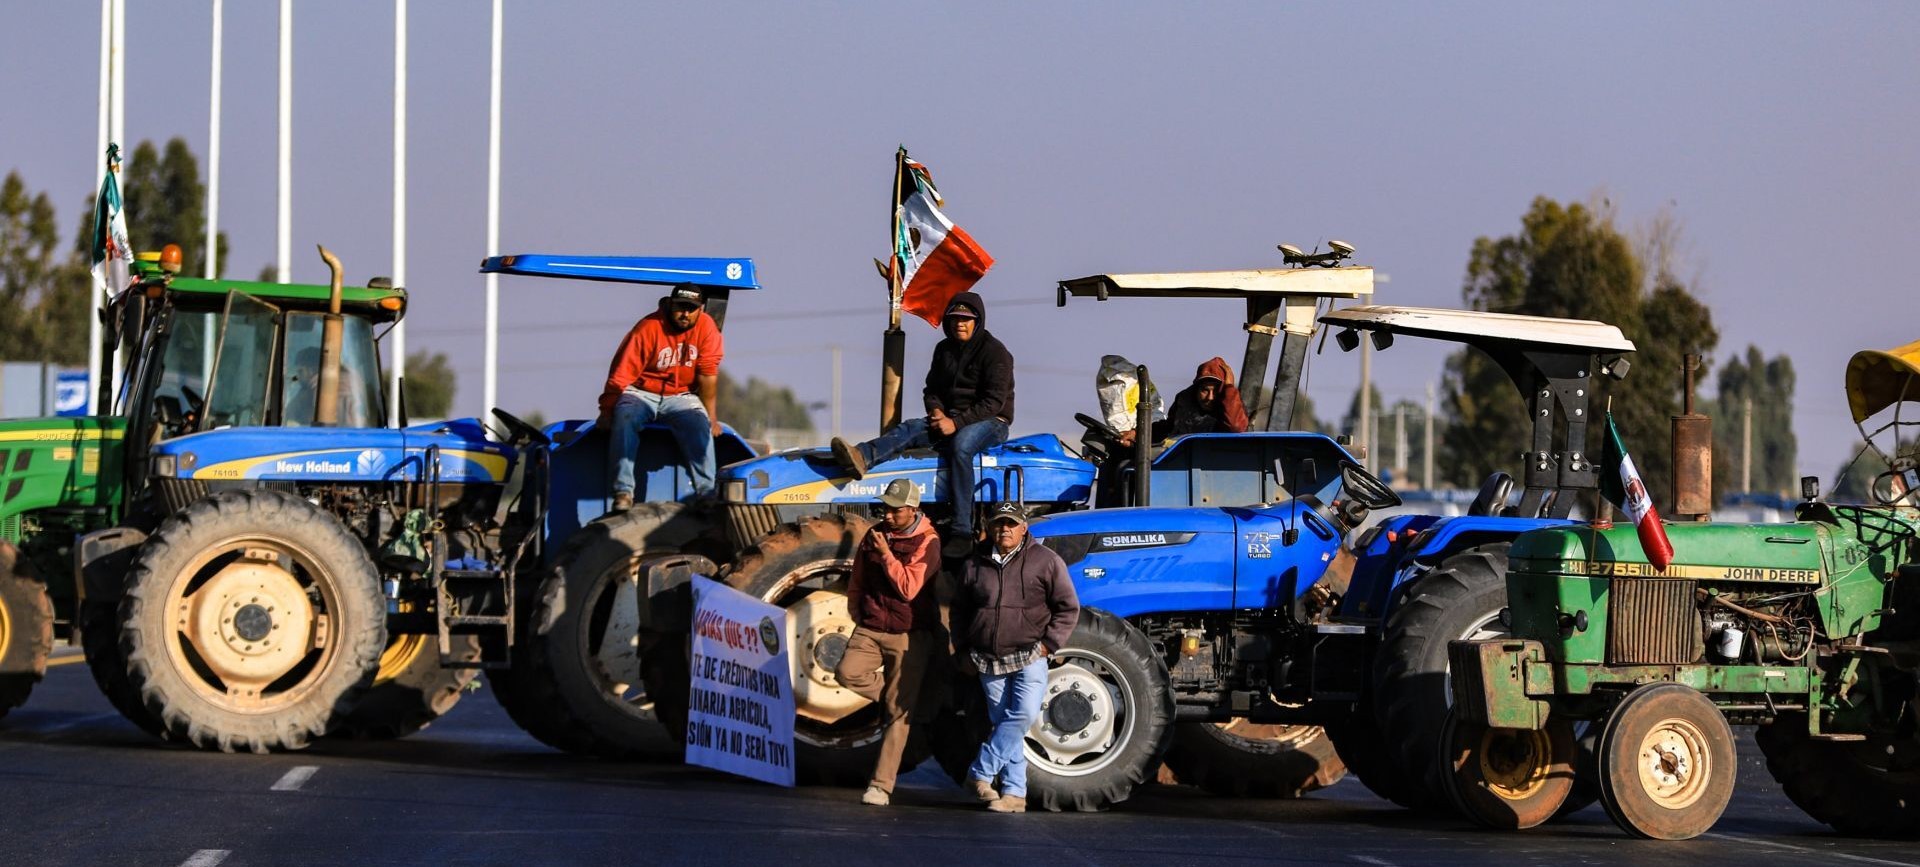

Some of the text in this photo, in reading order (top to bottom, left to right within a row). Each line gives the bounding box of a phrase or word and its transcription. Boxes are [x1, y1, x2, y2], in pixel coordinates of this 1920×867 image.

[213, 469, 239, 477] 7610S
[276, 460, 351, 473] New Holland
[850, 484, 877, 495] New
[784, 493, 811, 502] 7610S
[1102, 533, 1167, 547] SONALIKA
[1247, 543, 1271, 553] RX
[1590, 562, 1640, 576] 2755
[1723, 568, 1815, 582] JOHN DEERE
[723, 618, 744, 649] QUE
[744, 626, 759, 654] ??
[703, 655, 718, 681] DE
[718, 658, 758, 692] CRÉDITOS
[758, 671, 780, 699] PARA
[728, 696, 772, 734] AGRÍCOLA,
[688, 720, 712, 748] SIÓN
[715, 726, 727, 752] YA
[730, 730, 742, 756] NO
[744, 734, 767, 762] SERÁ
